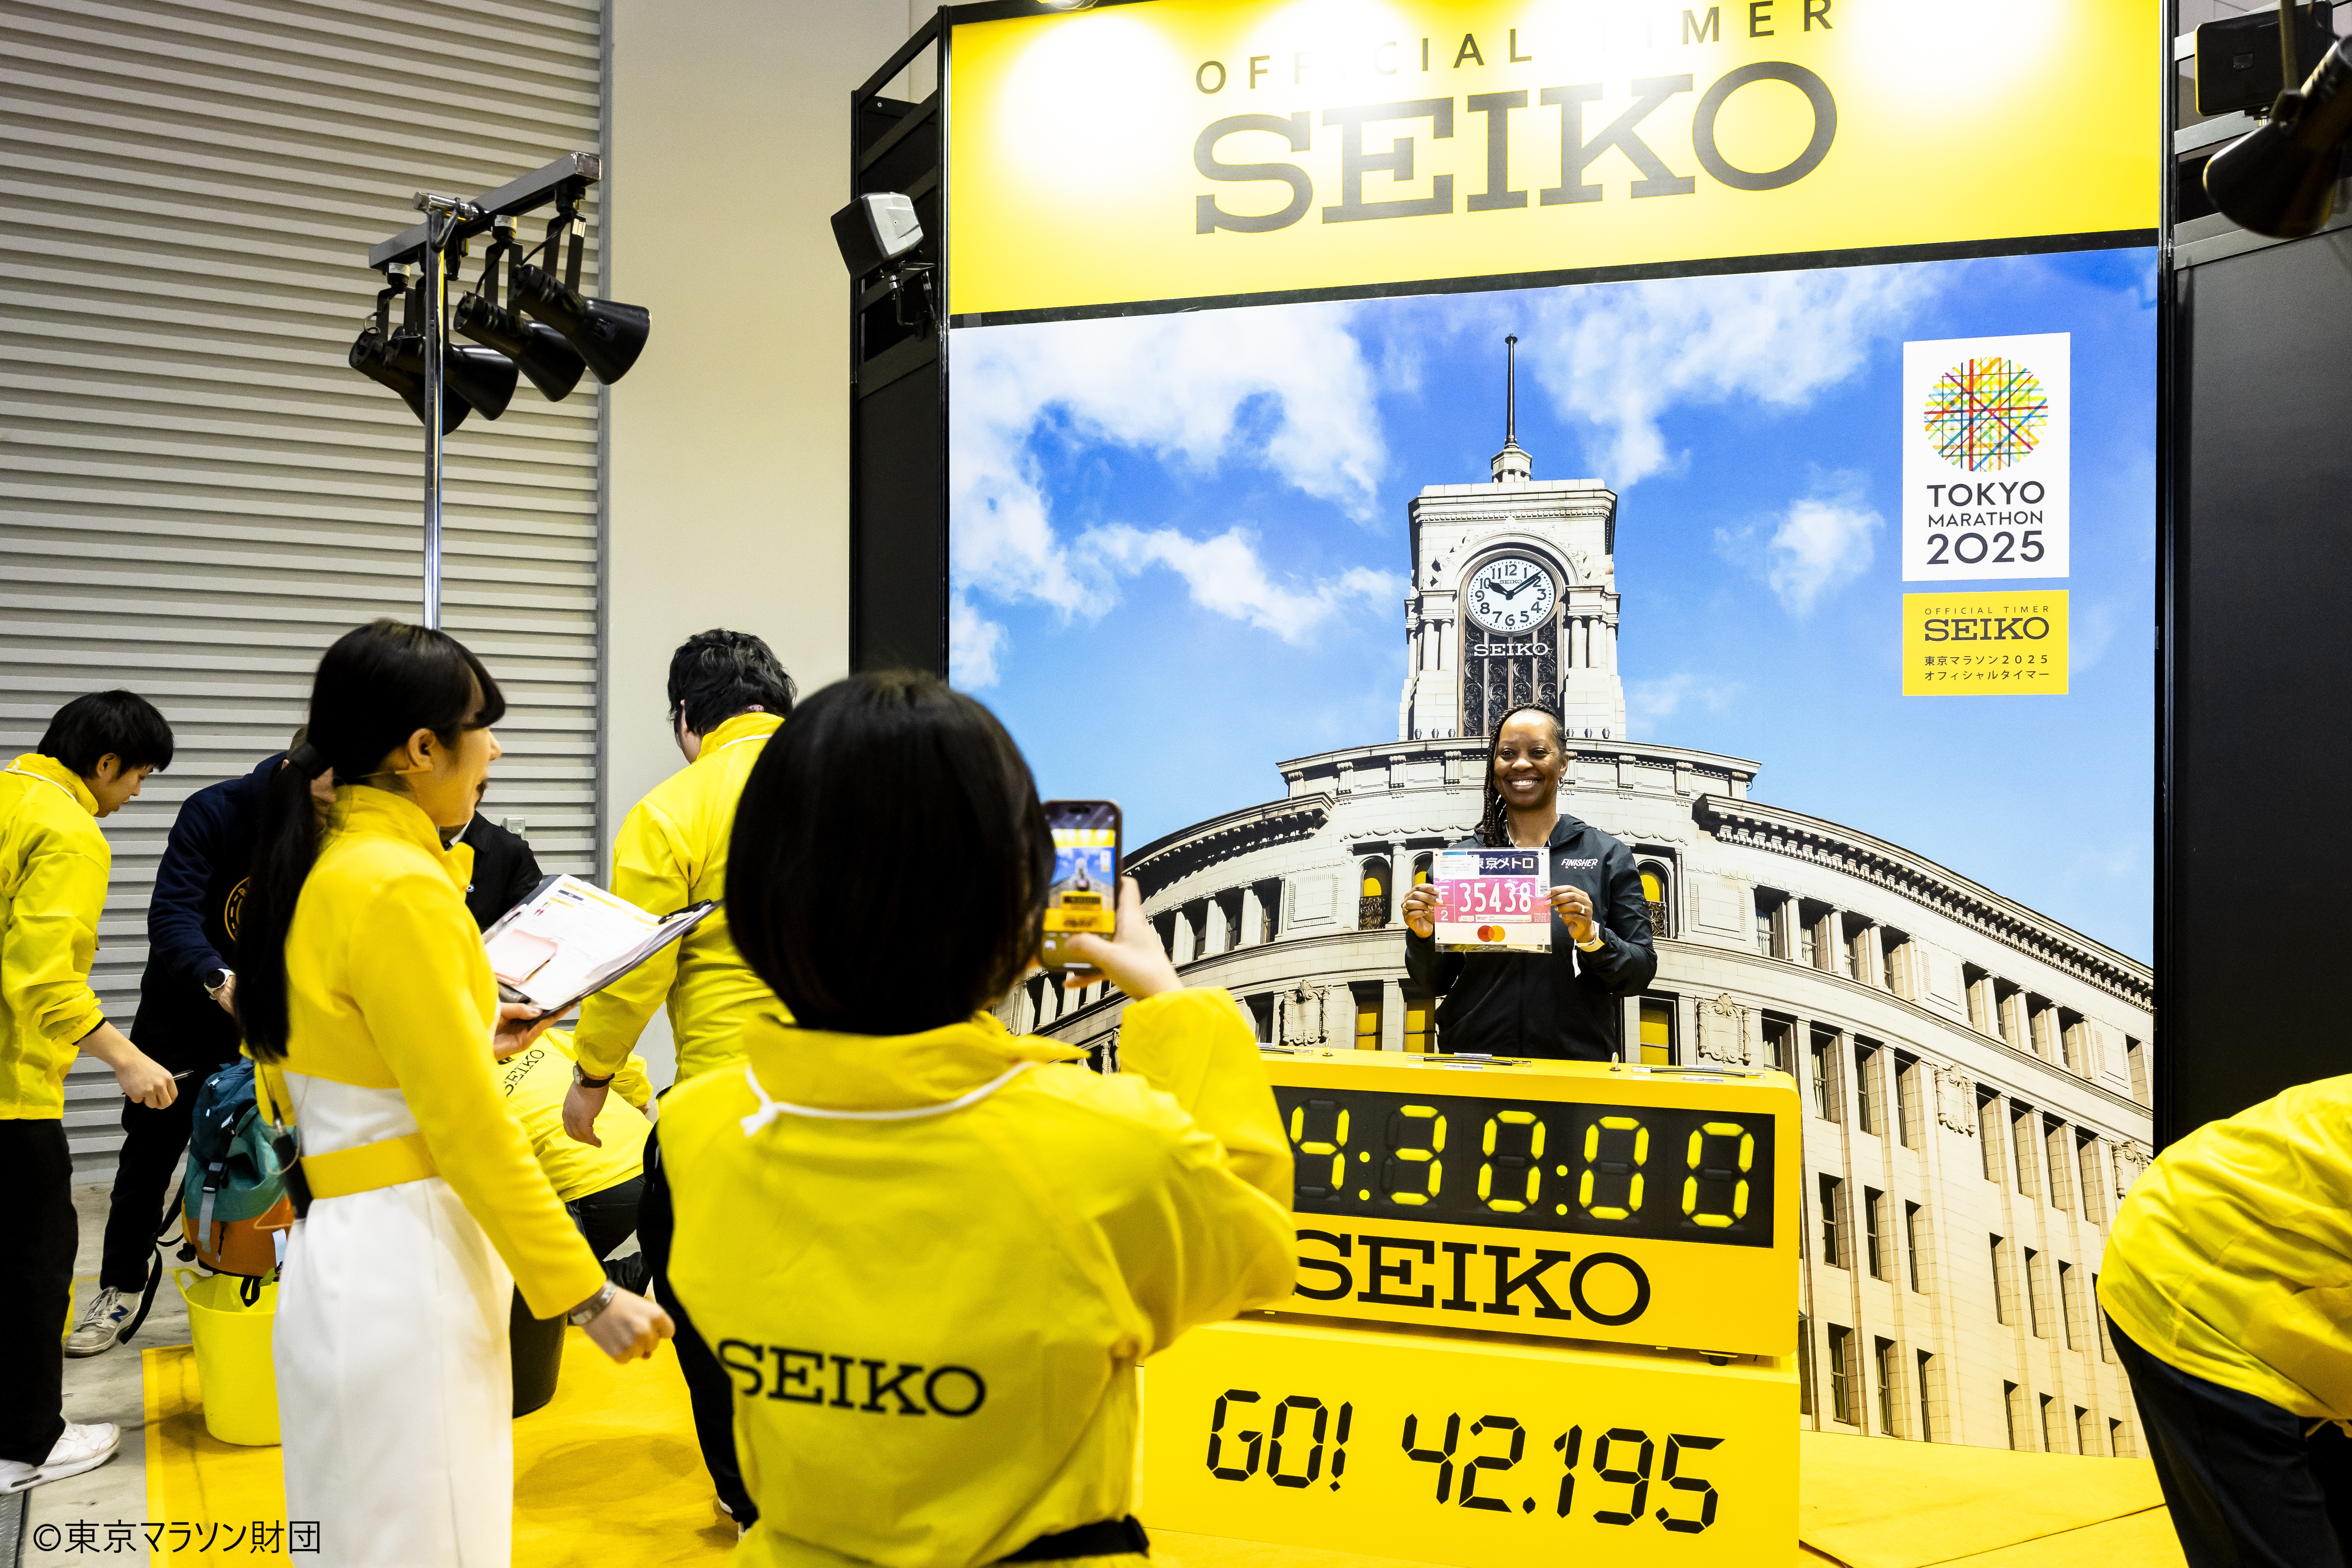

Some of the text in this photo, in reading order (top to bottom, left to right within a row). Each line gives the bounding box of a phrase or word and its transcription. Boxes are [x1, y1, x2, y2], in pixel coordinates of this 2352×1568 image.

[1196, 0, 1833, 94] OFFCIAL MER
[1194, 61, 1837, 235] SEIKO
[1927, 481, 2045, 507] TOKYO
[1929, 510, 2043, 527] MARATHON
[1927, 530, 2045, 564] 2025
[1492, 568, 1501, 579] 11
[1505, 564, 1517, 576] 12
[1524, 567, 1527, 579] 1
[1533, 576, 1541, 587] 2
[1475, 590, 1485, 602] 9
[1537, 589, 1546, 600] 3
[1480, 603, 1490, 614] 8
[1531, 601, 1542, 613] 4
[1492, 611, 1502, 623] 7
[1505, 614, 1515, 626] 6
[1520, 611, 1529, 622] 5
[1924, 617, 2049, 642] SEIKO
[1474, 643, 1548, 657] SEIKO
[1925, 655, 2049, 666] 東京マラソン2025
[1925, 670, 2049, 681] オフィシャルタイマー
[1561, 858, 1598, 867] FINISHER
[1459, 882, 1531, 913] 35438
[1441, 909, 1448, 921] 2
[1291, 1229, 1651, 1326] SEIKO
[718, 1338, 987, 1419] SEIKO
[1207, 1389, 1726, 1534] GO! 42.195
